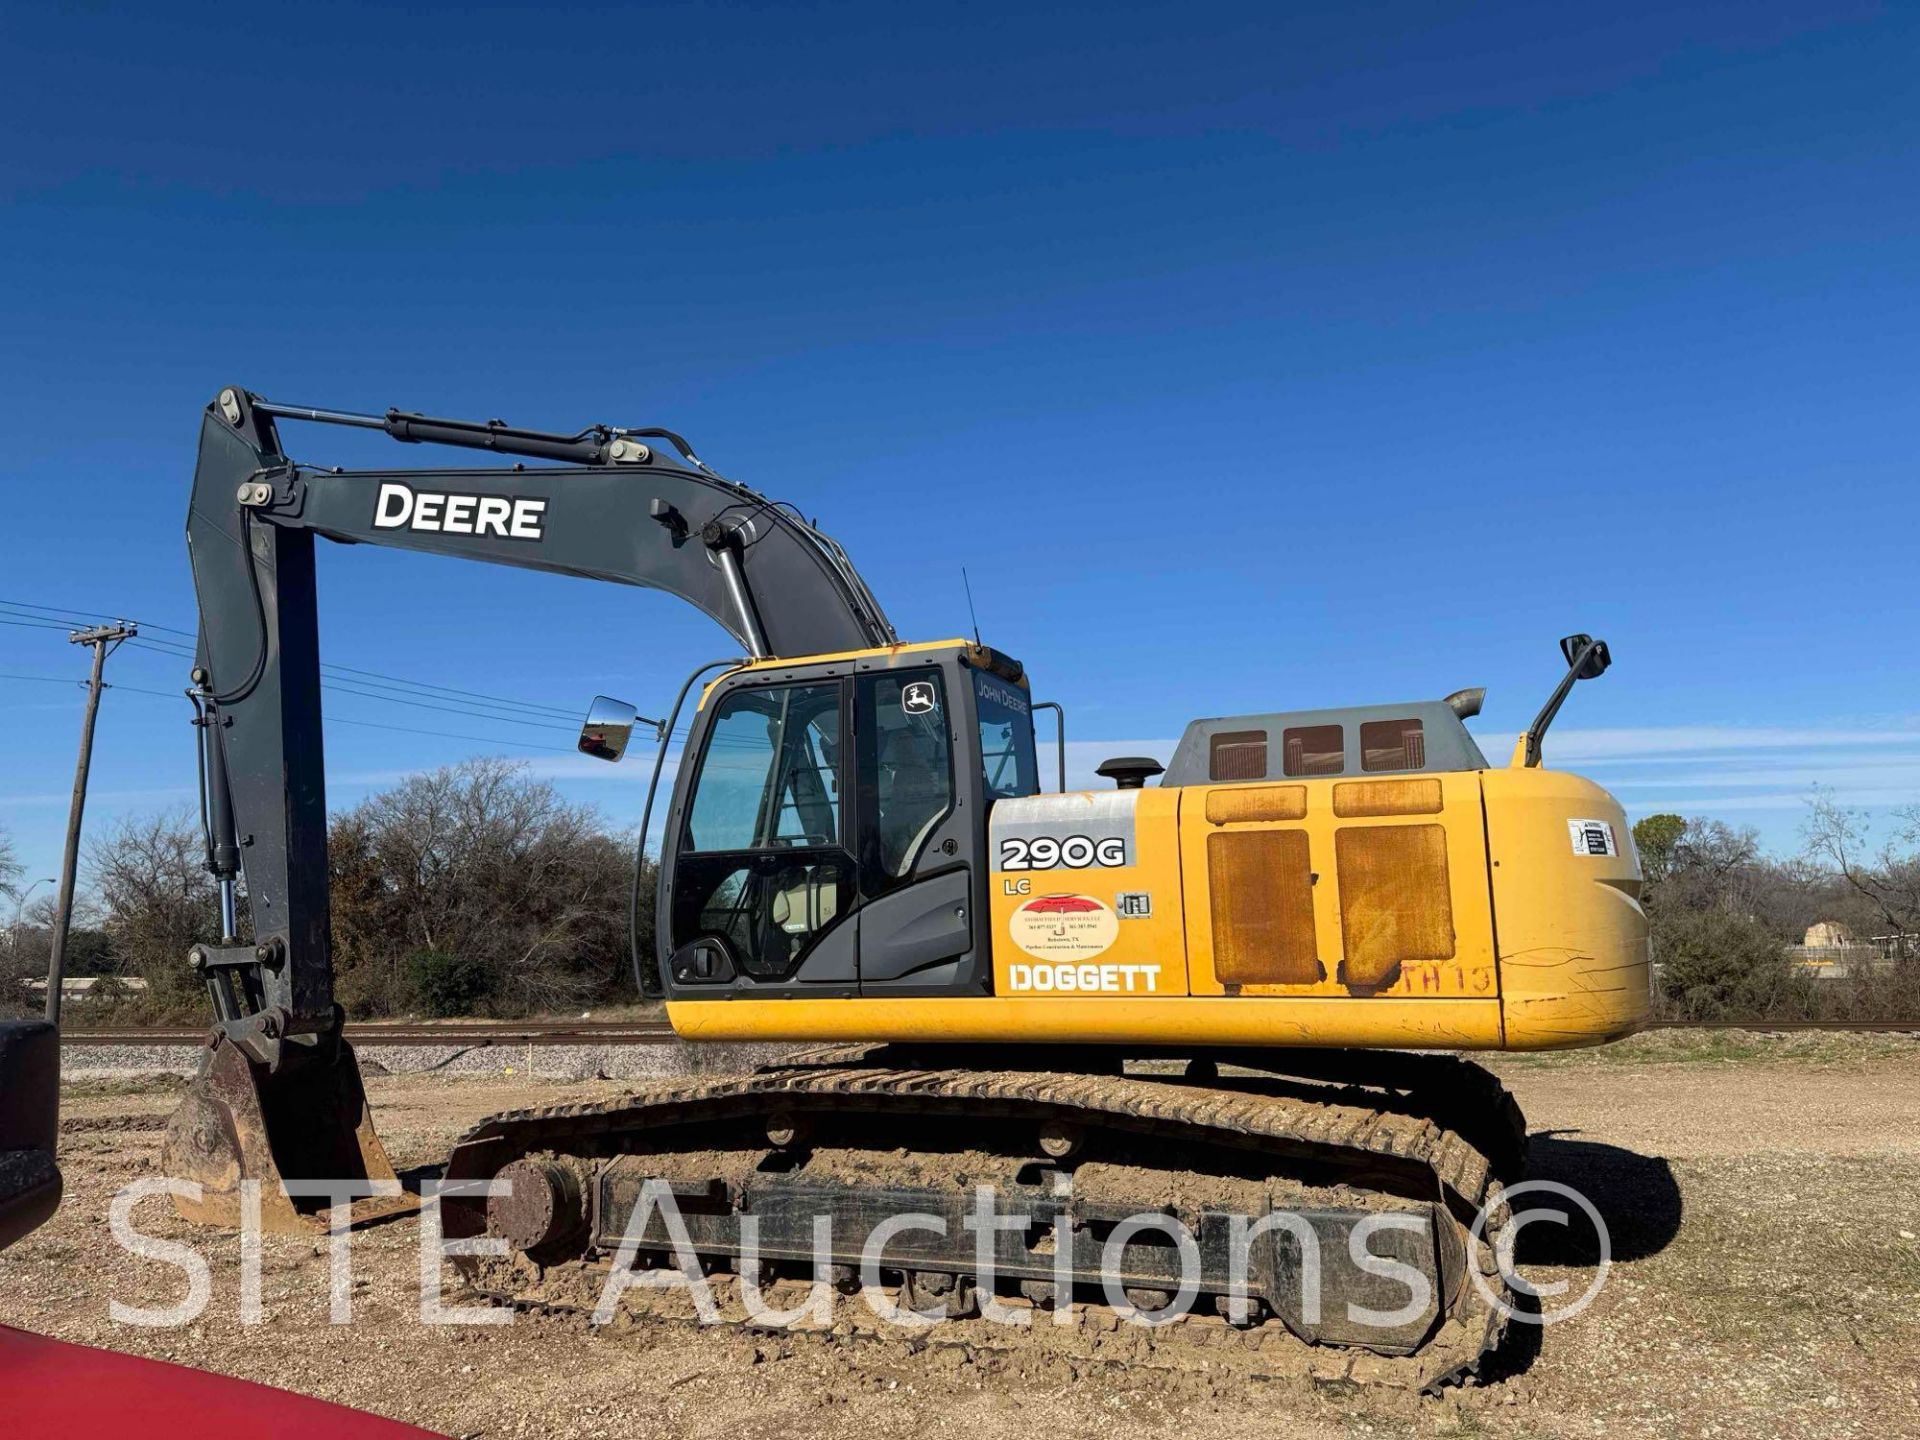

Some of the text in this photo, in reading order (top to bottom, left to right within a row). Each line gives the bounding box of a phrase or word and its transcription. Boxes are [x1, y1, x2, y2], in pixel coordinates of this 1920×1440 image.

[375, 483, 546, 539] DEERE
[979, 680, 1028, 716] JOHN DEERE
[1001, 835, 1126, 872] 290G
[1004, 879, 1031, 895] LC
[1009, 964, 1162, 992] DOGGETT
